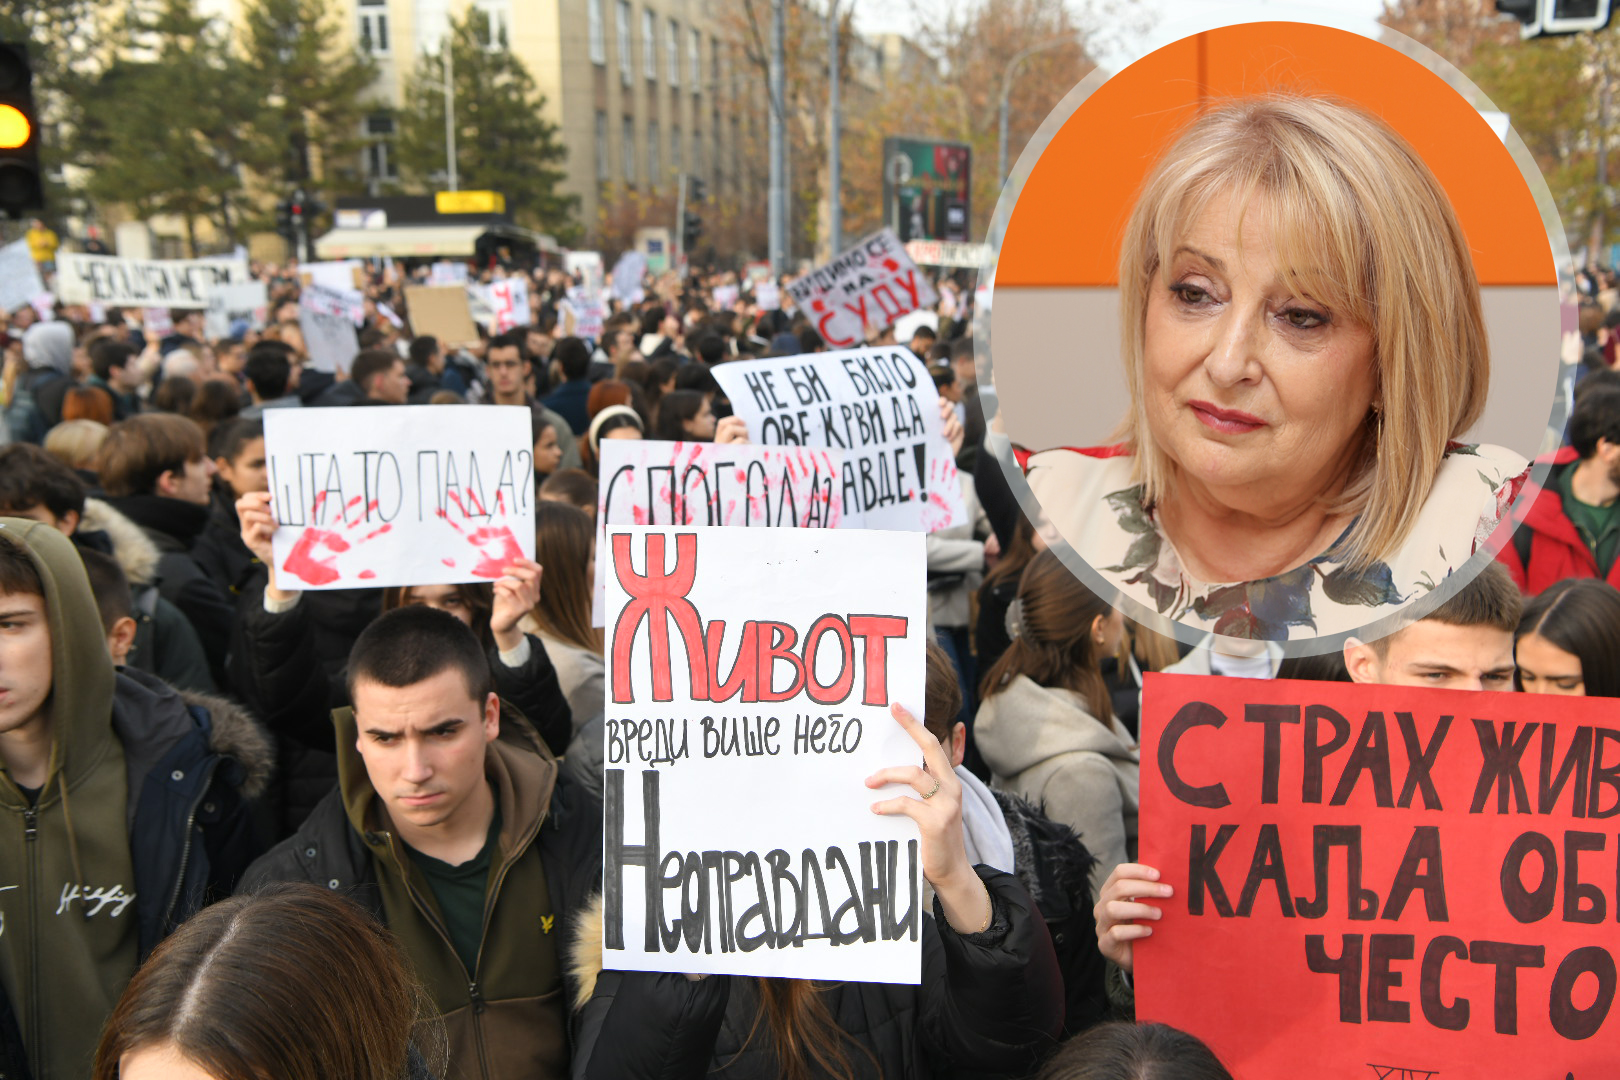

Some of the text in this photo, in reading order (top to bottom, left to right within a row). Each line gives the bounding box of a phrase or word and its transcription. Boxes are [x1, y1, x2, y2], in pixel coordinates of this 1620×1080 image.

[818, 269, 920, 346] СУДУ
[842, 273, 875, 296] НА
[744, 352, 917, 413] НЕ БИ БИЛО
[761, 394, 926, 450] ОВЕ КРВИ ДА
[271, 449, 533, 527] ШТА ТО ПАДА?
[842, 442, 928, 517] АВДЕ!
[1157, 701, 1455, 812] СТРАХ
[1187, 823, 1620, 925] КАЉА ОБ
[1304, 932, 1618, 1041] ЧЕСТО
